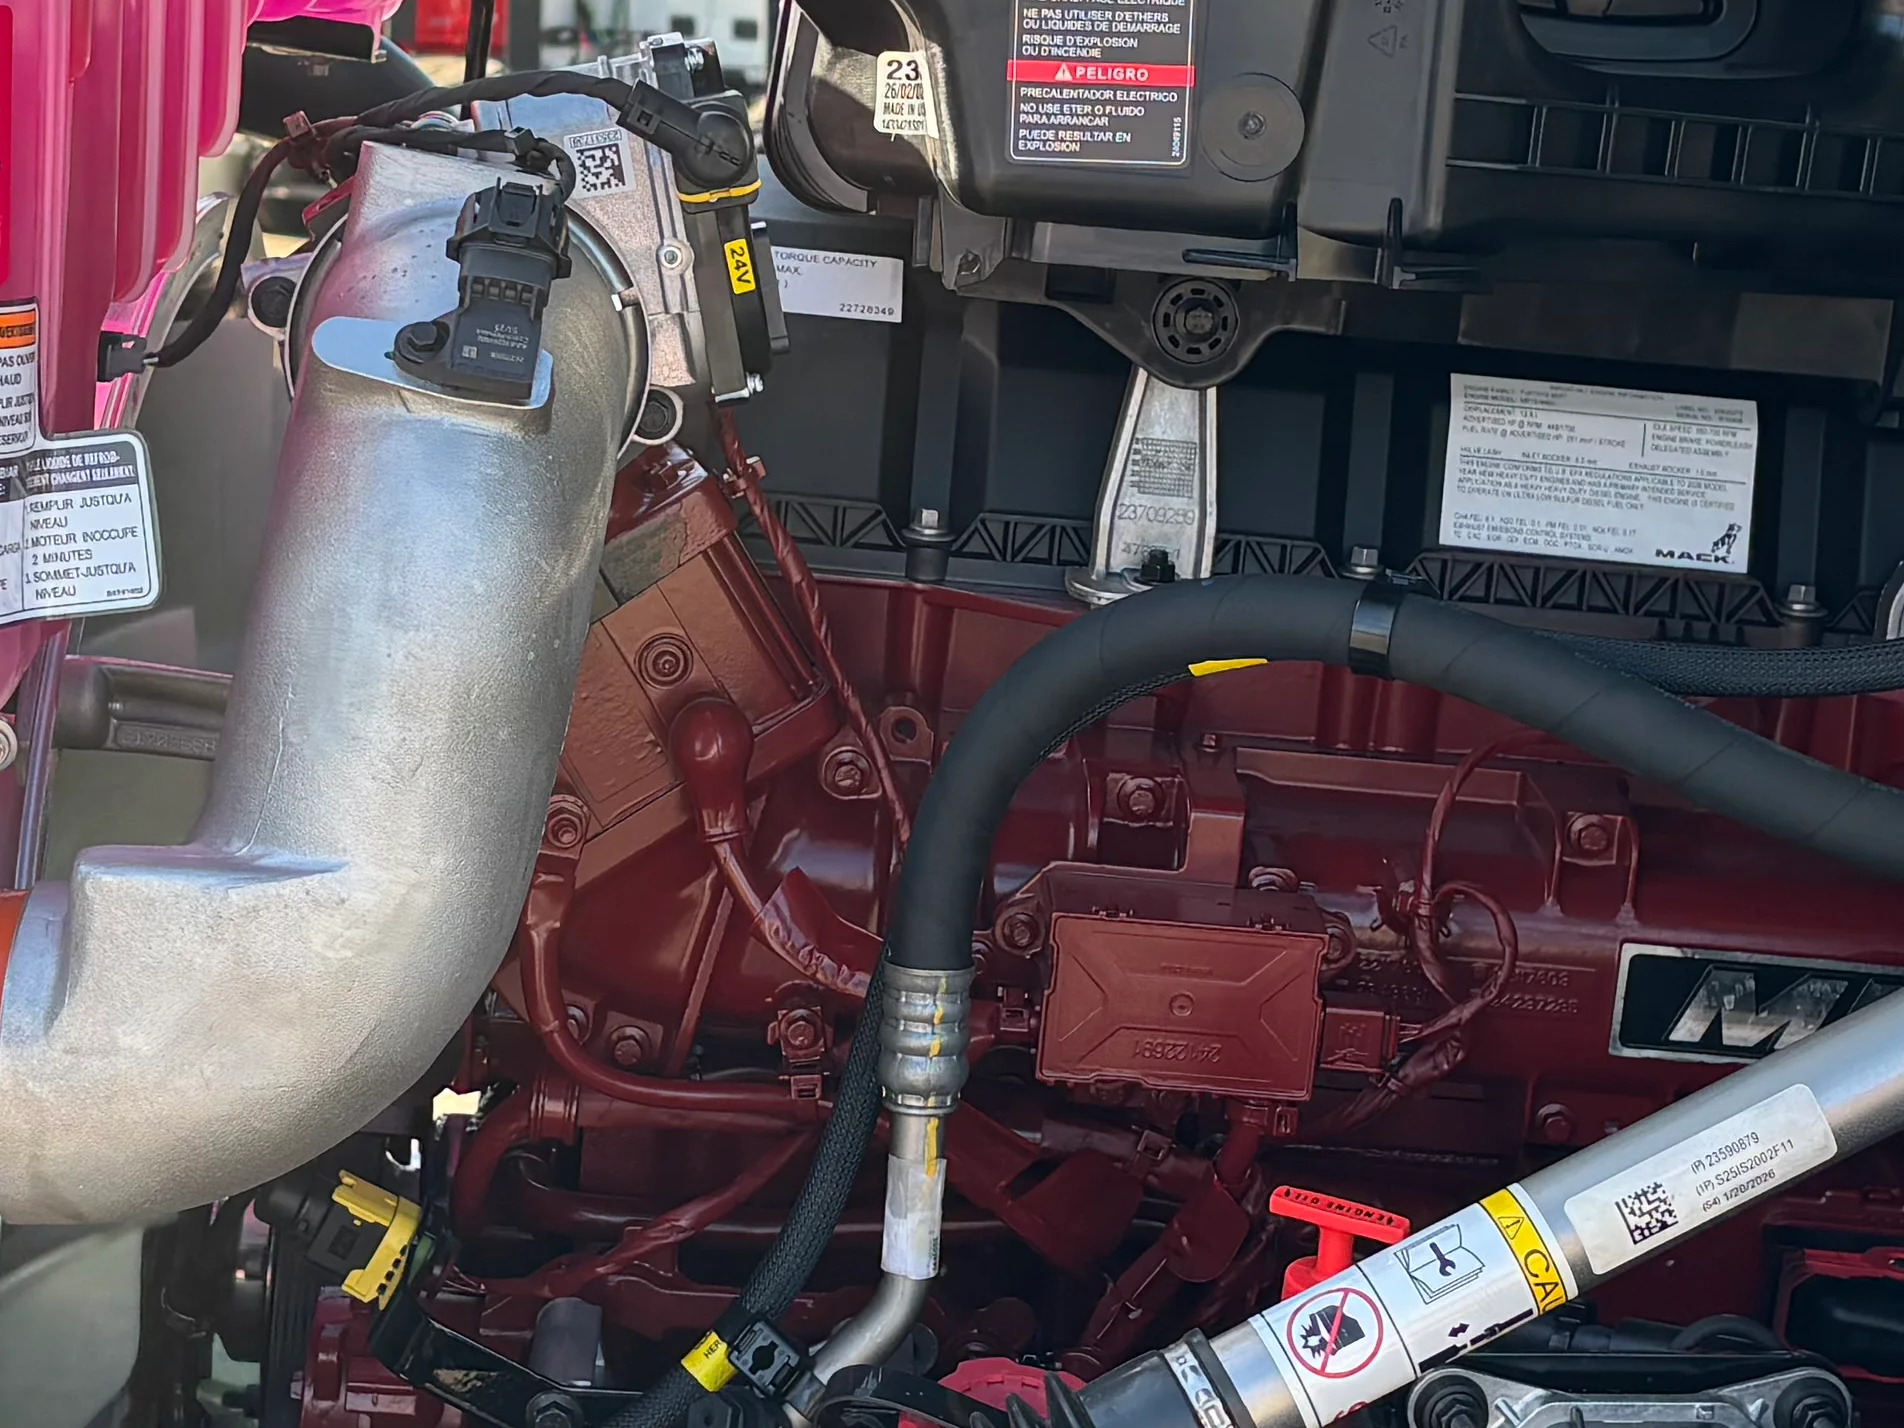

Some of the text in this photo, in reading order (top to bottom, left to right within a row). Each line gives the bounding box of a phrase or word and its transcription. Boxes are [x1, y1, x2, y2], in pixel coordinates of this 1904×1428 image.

[1023, 9, 1038, 18] NE
[1041, 9, 1061, 19] PAS
[1065, 10, 1112, 20] UTILISER
[1023, 19, 1039, 29] OU
[1042, 20, 1092, 31] LIQUIDES
[1096, 22, 1109, 31] DE
[1022, 35, 1063, 45] RISQUE
[1022, 46, 1038, 55] OU
[1076, 67, 1148, 81] PELIGRO
[1020, 87, 1114, 100] PRECALENTADOR
[1020, 103, 1144, 116] NO USE ETER O FLUIDO
[1020, 114, 1046, 124] PARA
[1019, 129, 1130, 142] PUEDE RESULTAR EN
[1019, 140, 1080, 152] EXPLOSION
[730, 247, 751, 284] 24V
[823, 255, 878, 268] CAPACITY
[1655, 548, 1728, 563] MACK
[1691, 1132, 1759, 1174] (P) 23590879
[1723, 1169, 1775, 1201] 1/20/2026
